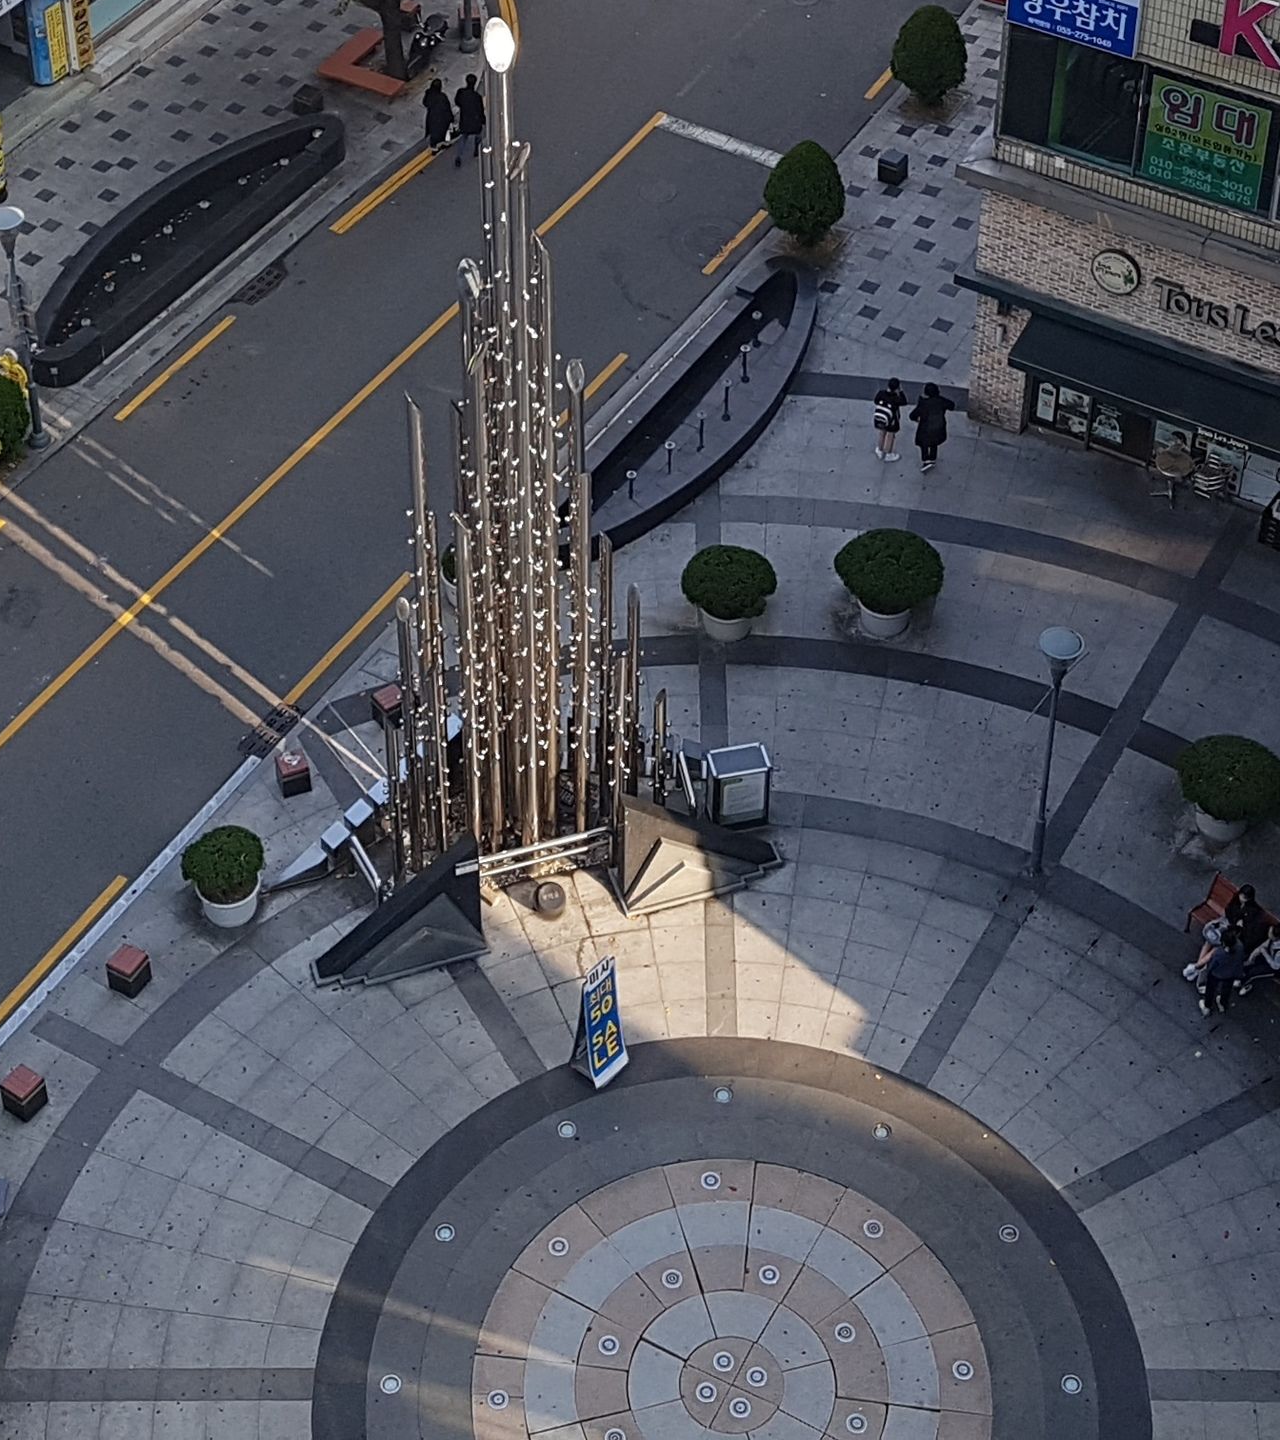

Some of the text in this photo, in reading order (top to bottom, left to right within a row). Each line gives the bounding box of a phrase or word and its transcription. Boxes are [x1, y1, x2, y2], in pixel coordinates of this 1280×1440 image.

[1159, 82, 1261, 152] 임대
[1152, 276, 1231, 330] Tous
[590, 995, 613, 1027] 50
